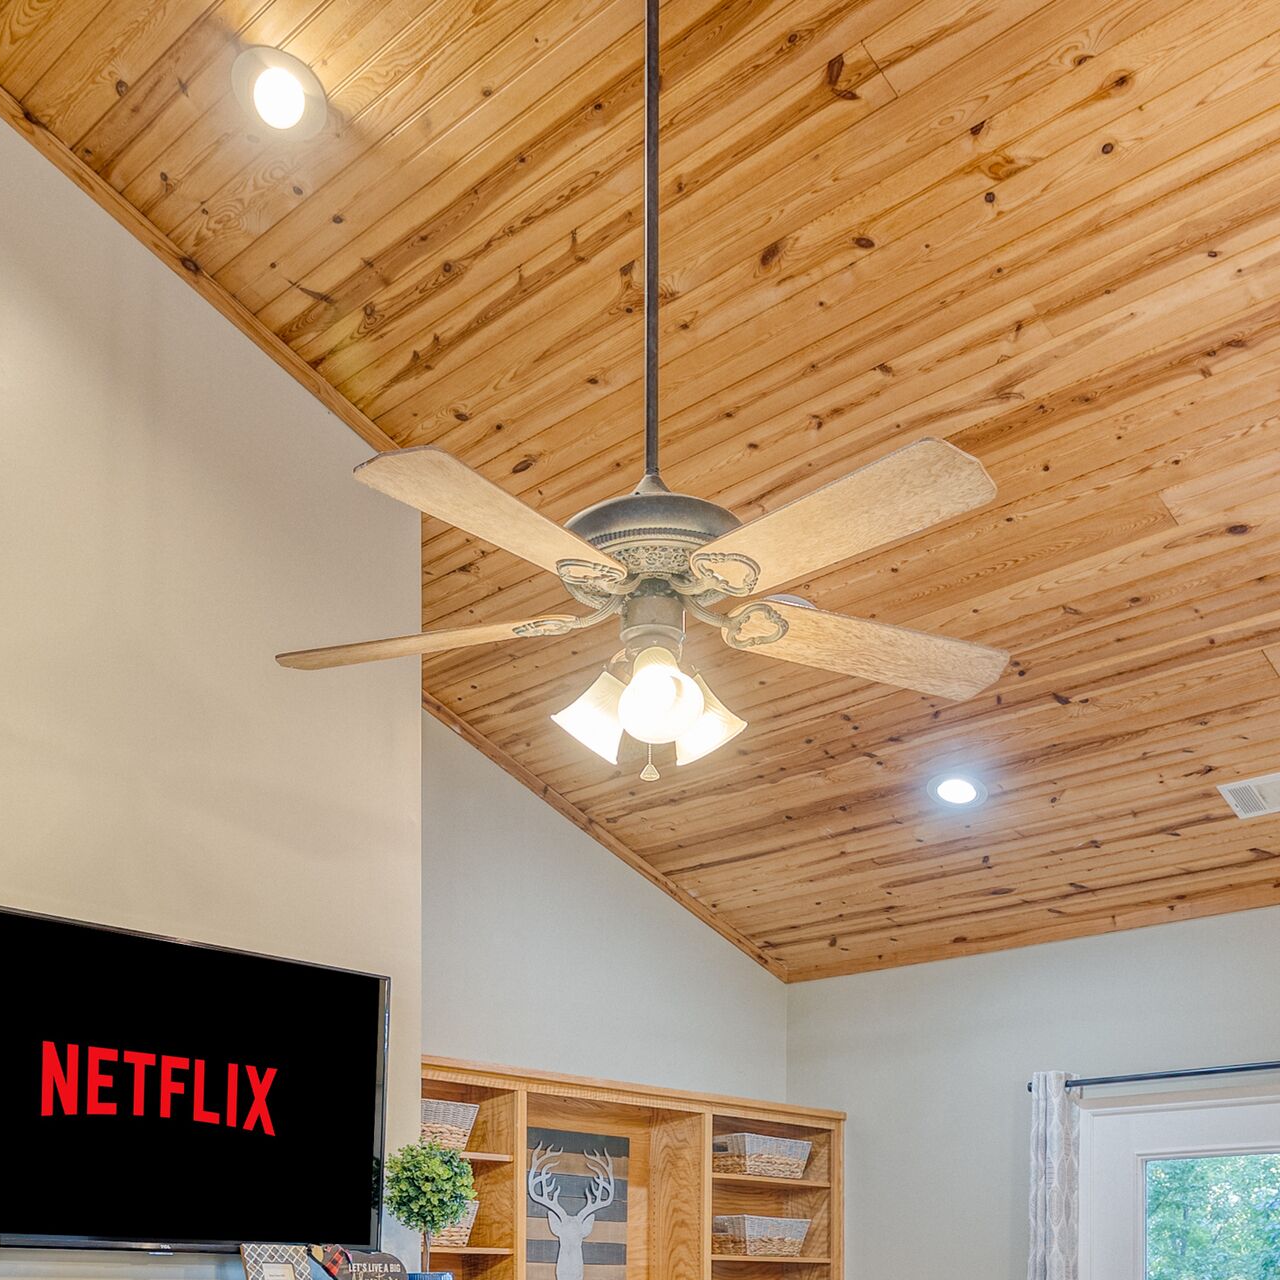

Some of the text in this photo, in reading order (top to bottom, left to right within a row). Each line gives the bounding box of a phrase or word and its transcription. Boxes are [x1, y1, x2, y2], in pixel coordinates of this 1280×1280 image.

[41, 1040, 278, 1137] NETFLIX
[348, 1262, 368, 1273] LET'S
[369, 1263, 383, 1273] LIVE
[384, 1263, 389, 1273] A
